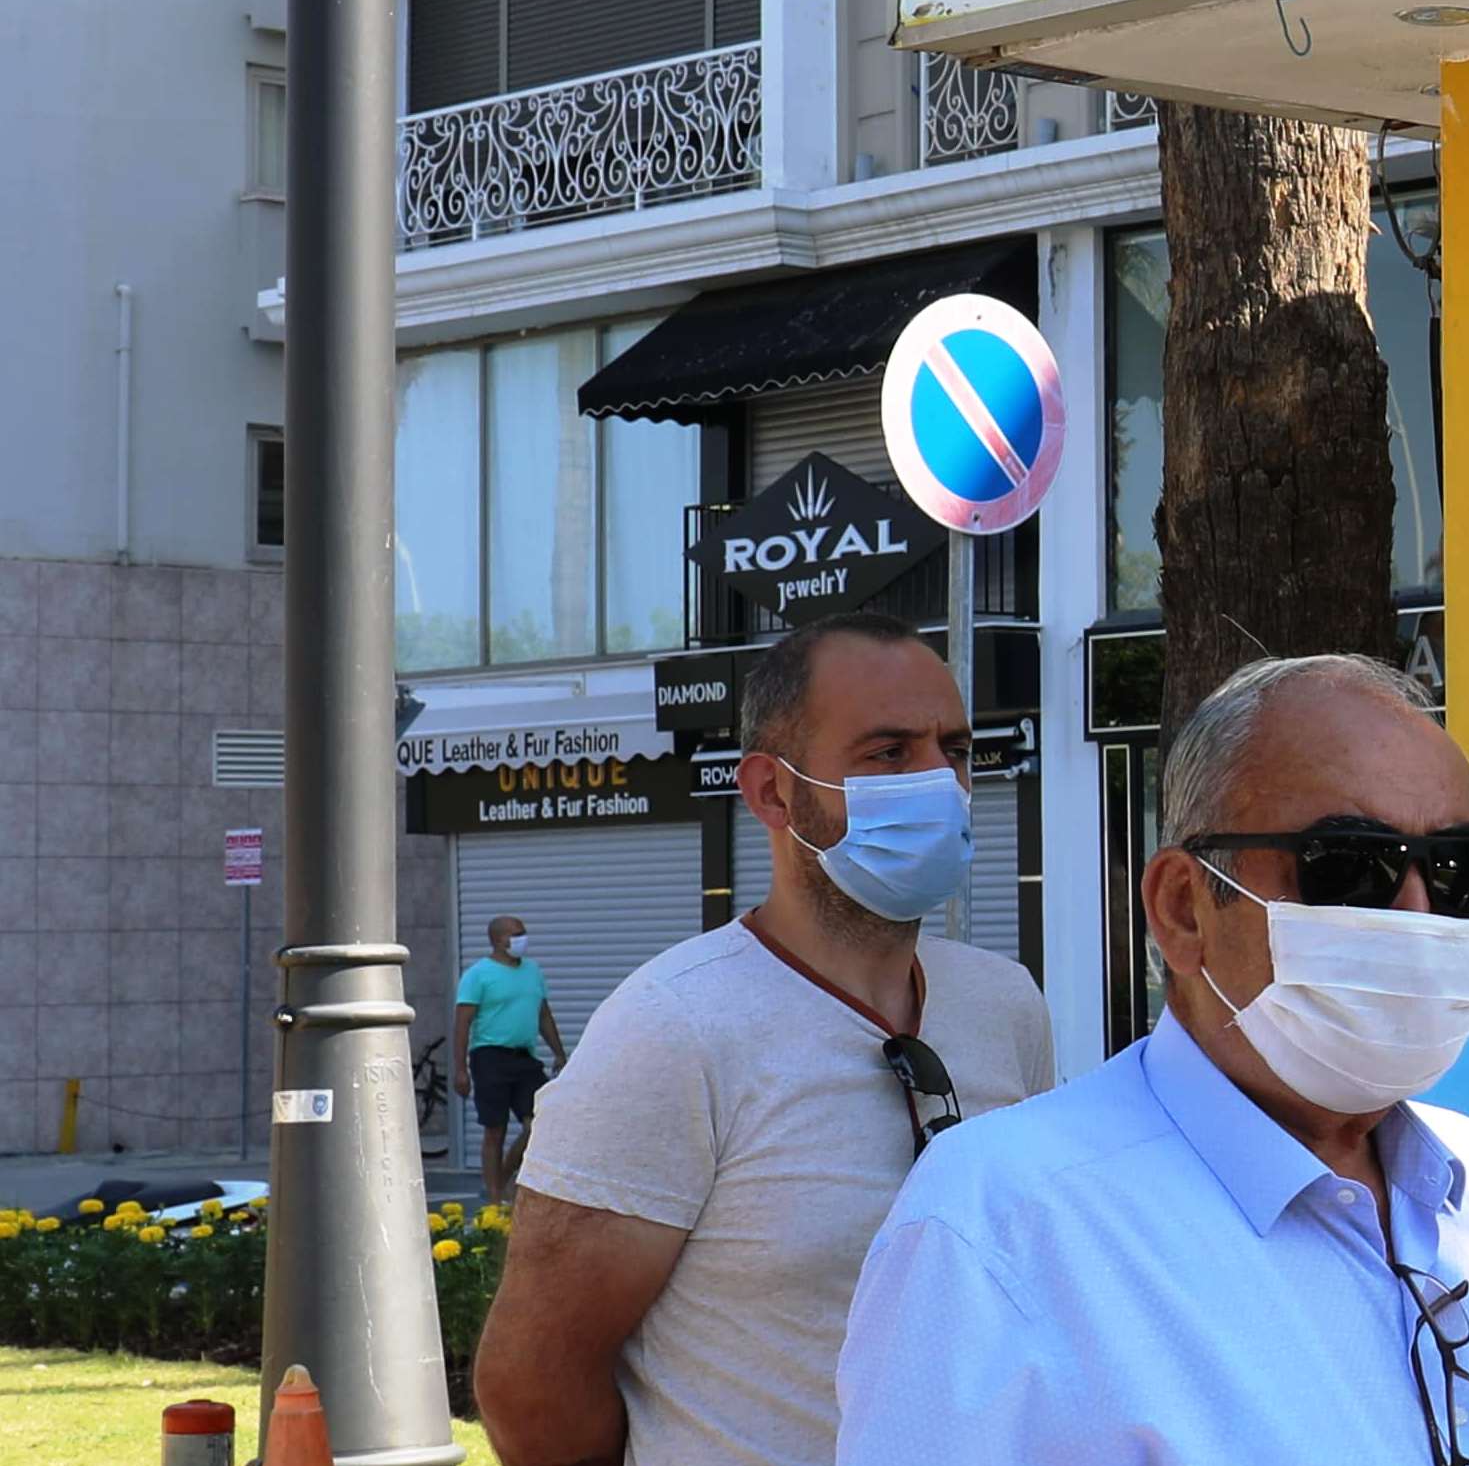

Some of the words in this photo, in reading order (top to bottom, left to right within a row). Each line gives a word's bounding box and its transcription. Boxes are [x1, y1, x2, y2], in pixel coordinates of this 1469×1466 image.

[723, 519, 908, 574] ROYAL
[657, 681, 728, 706] DIAMOND
[442, 735, 501, 763] Leather
[505, 733, 519, 758] &
[524, 731, 550, 756] Fur
[554, 727, 620, 754] Fashion
[500, 761, 628, 792] UNIQUE
[479, 795, 537, 822] Leather
[541, 793, 555, 819] &
[557, 793, 582, 817] Fur
[587, 791, 649, 816] Fashion
